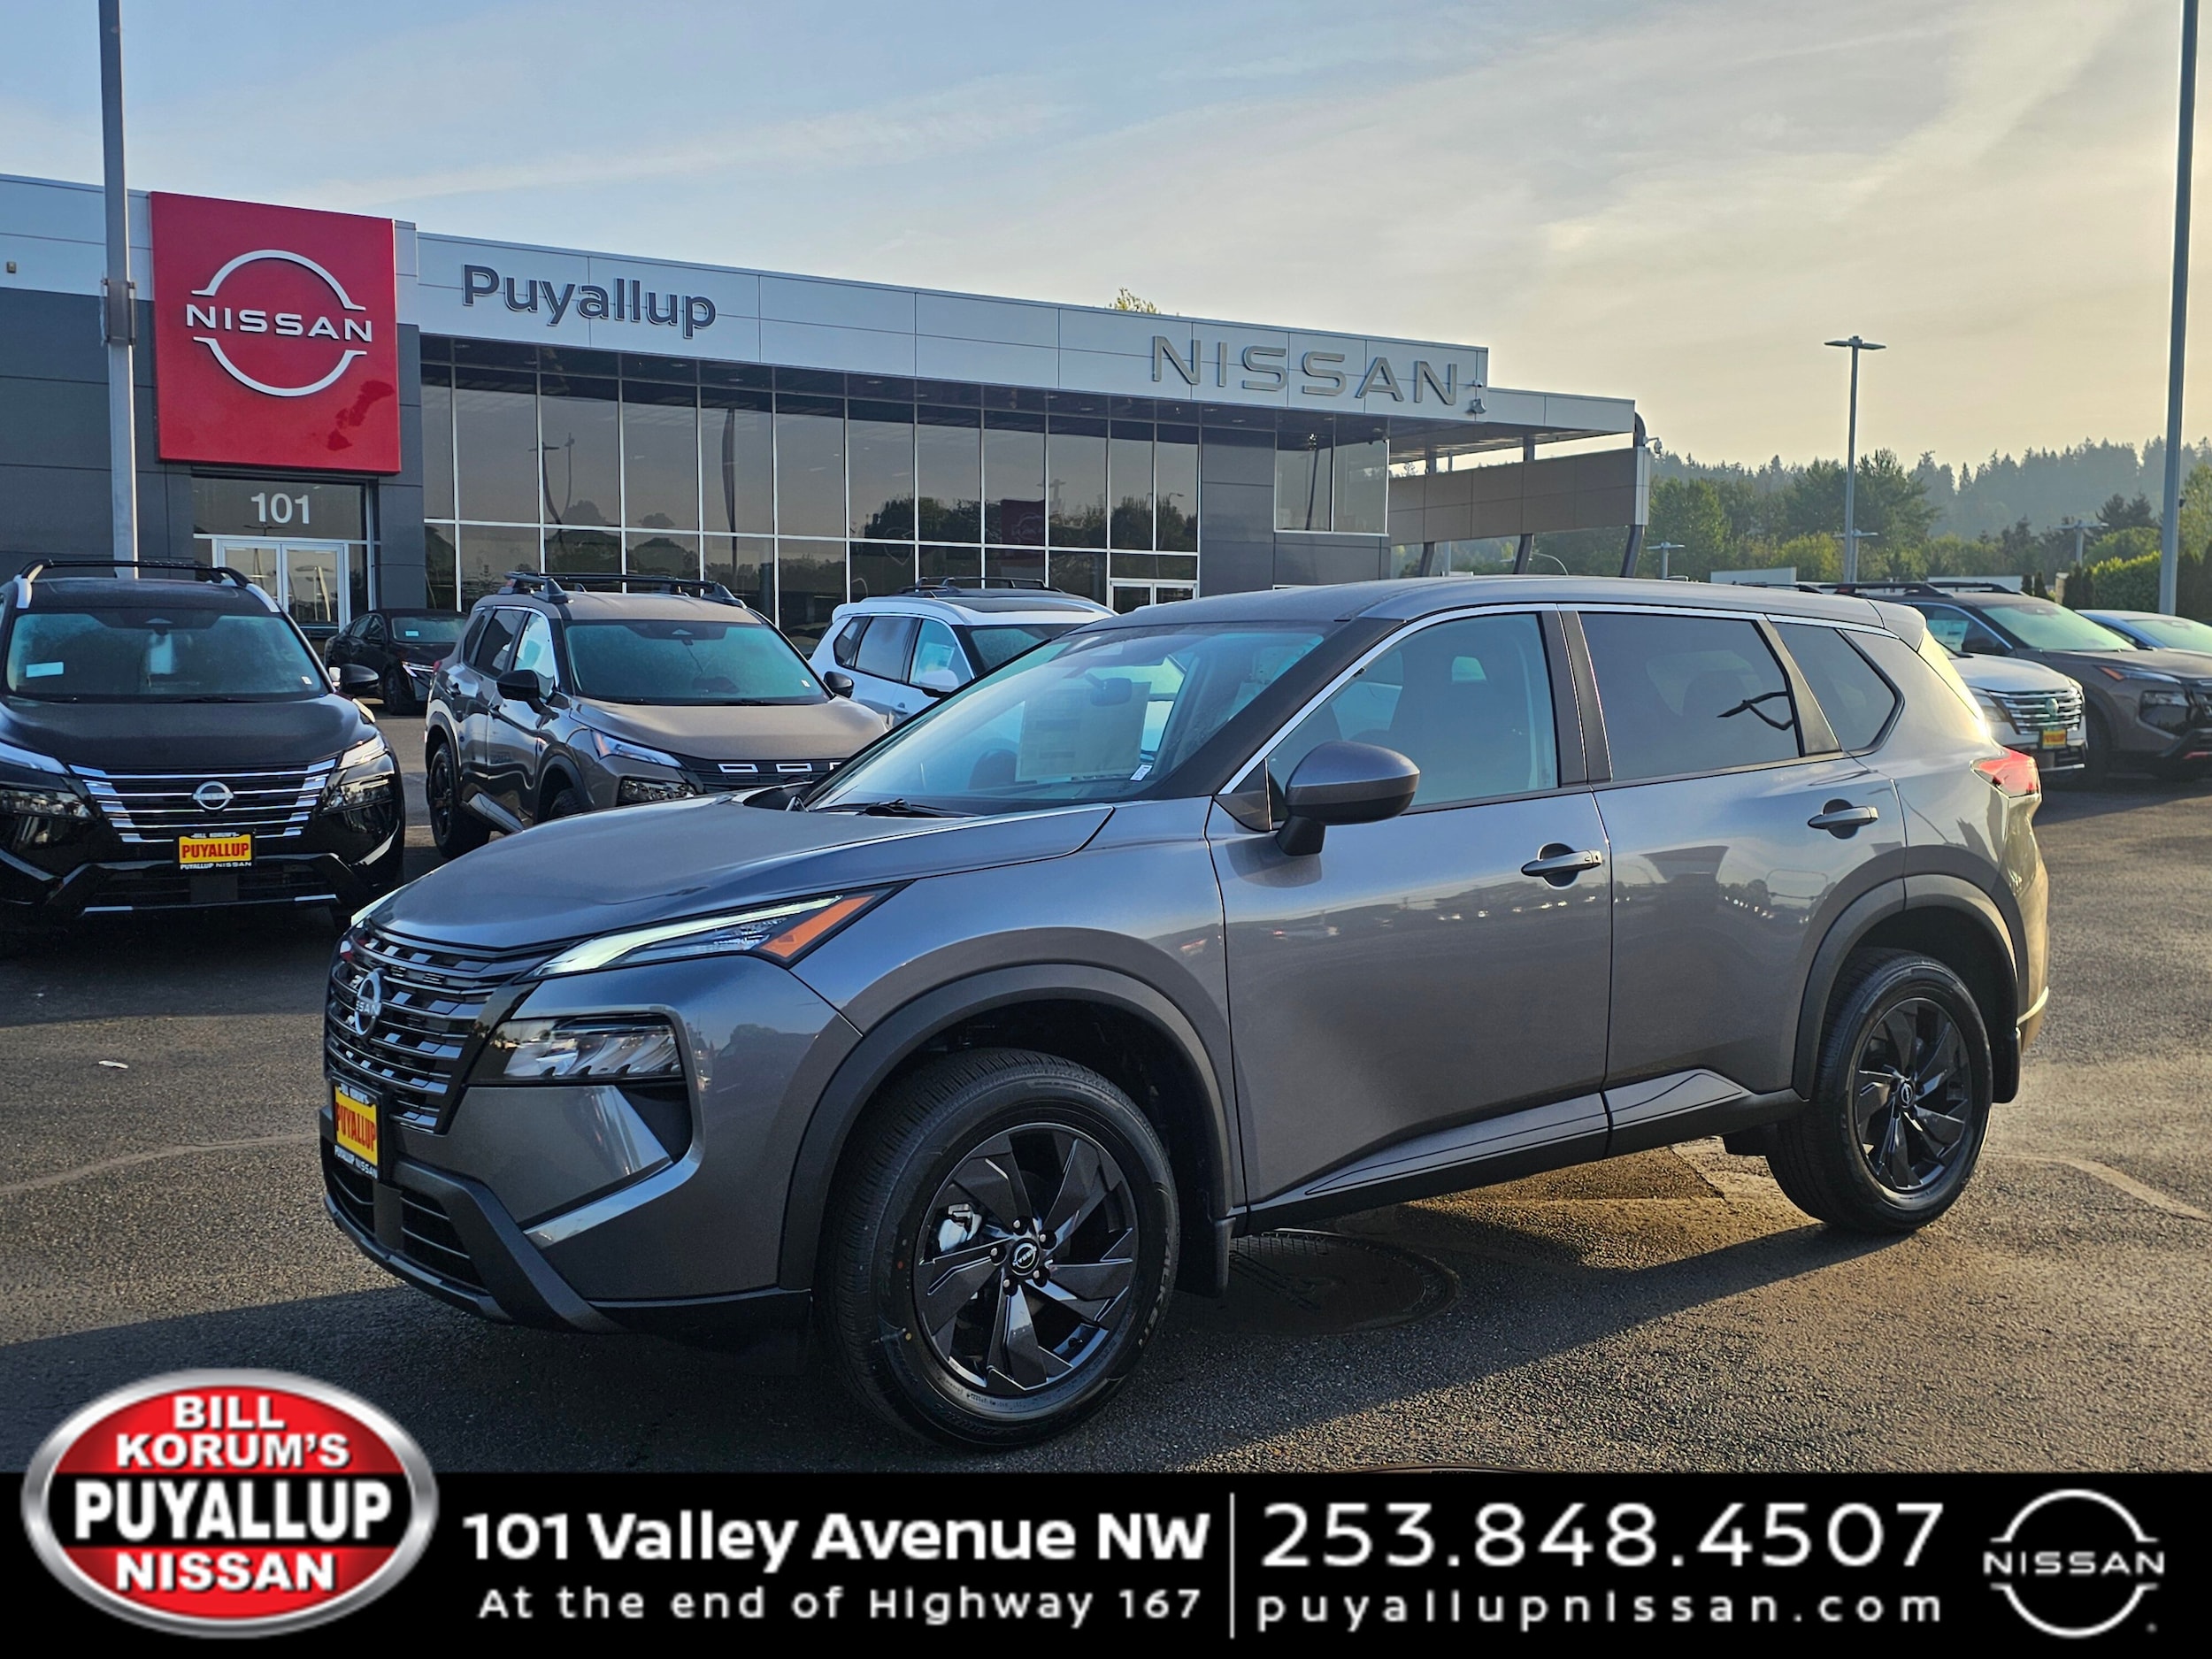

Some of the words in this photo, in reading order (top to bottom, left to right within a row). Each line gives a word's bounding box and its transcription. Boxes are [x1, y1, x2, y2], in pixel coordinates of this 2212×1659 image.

[186, 303, 373, 342] NISSAN
[462, 264, 717, 339] Puyallup
[1152, 335, 1457, 406] NISSAN
[250, 492, 310, 525] 101
[181, 842, 250, 858] PUYALLUP
[334, 1102, 377, 1152] PUYALLUP
